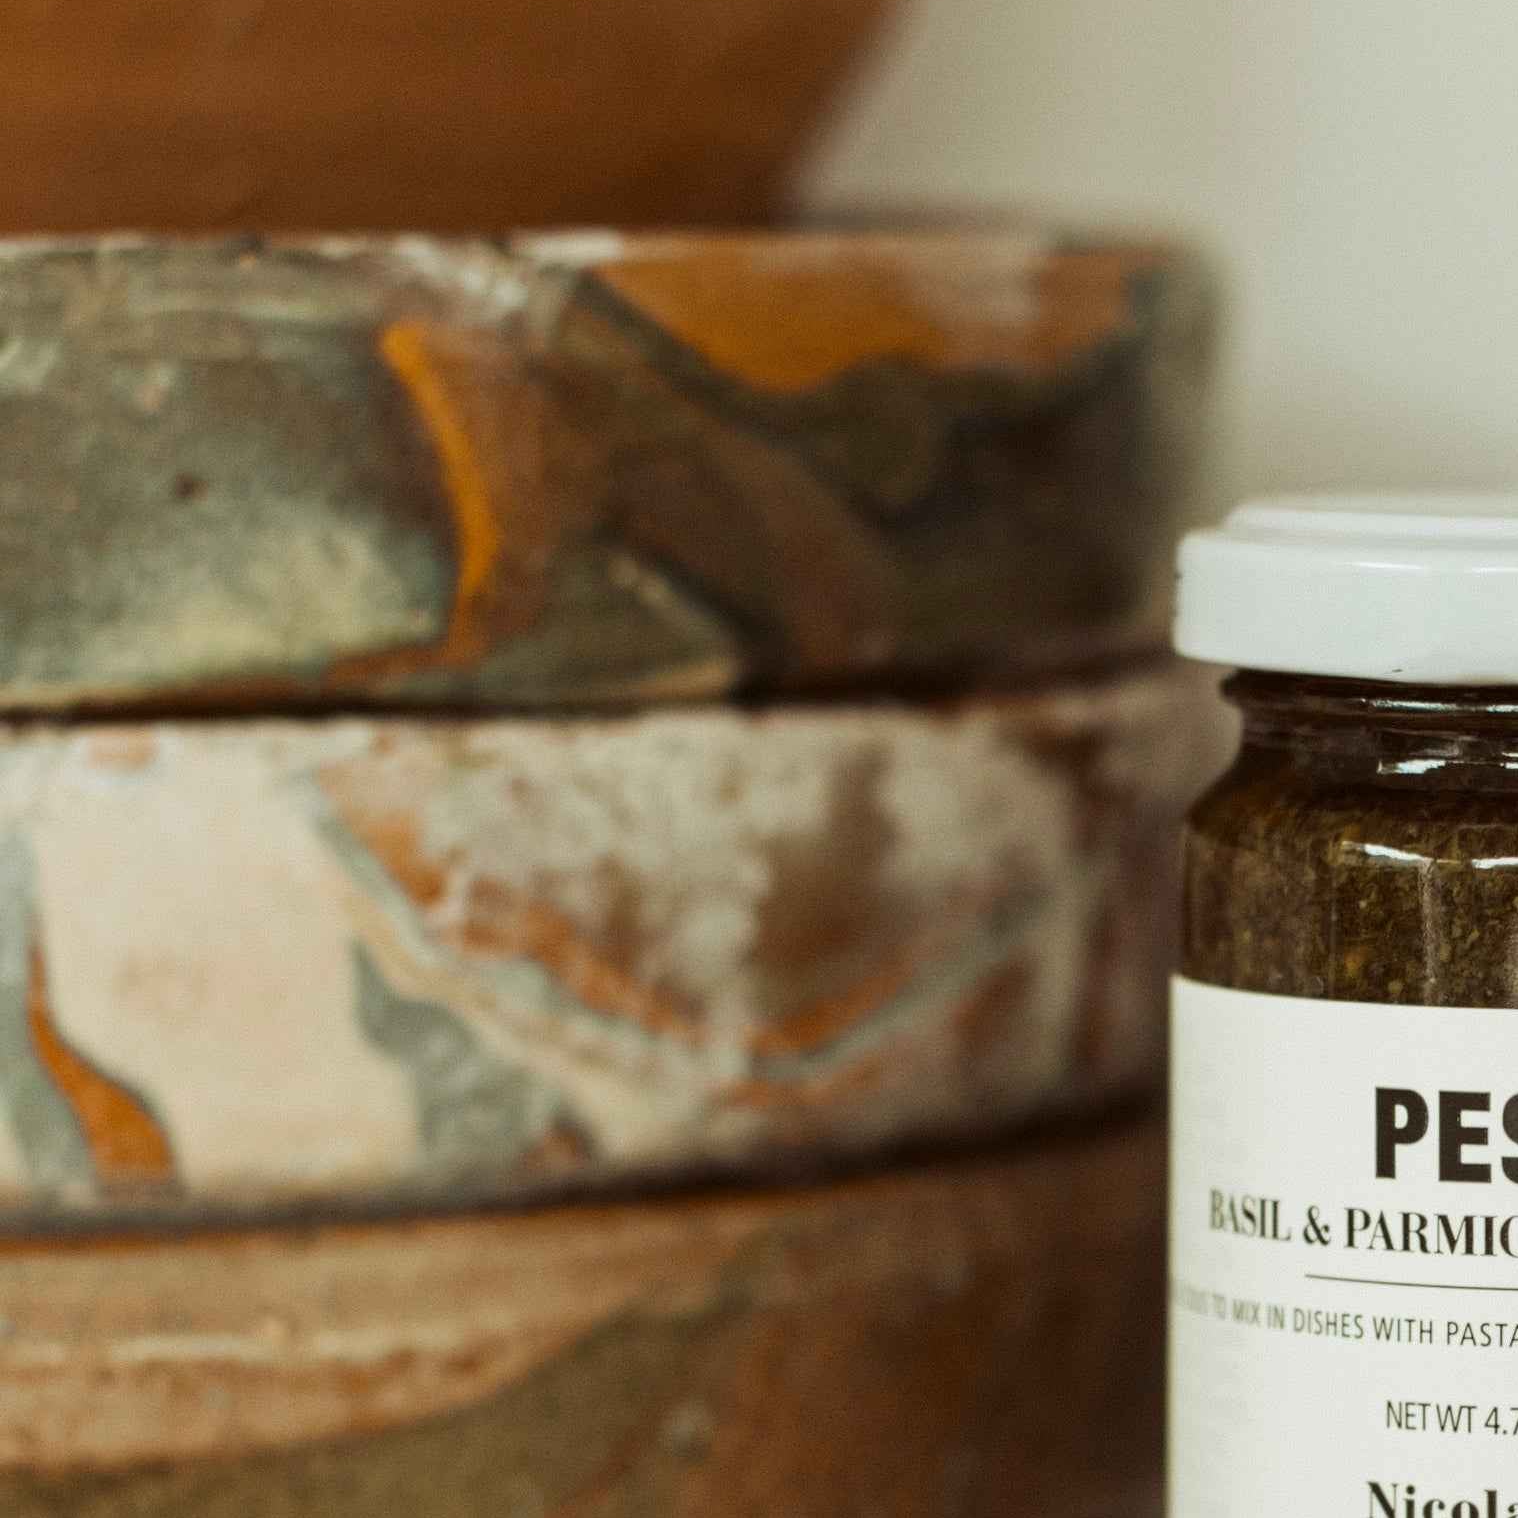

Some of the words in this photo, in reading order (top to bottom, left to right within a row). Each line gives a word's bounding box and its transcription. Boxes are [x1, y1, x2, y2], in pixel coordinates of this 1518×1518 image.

[1209, 1189, 1292, 1242] BASIL
[1303, 1205, 1331, 1247] &
[1231, 1299, 1261, 1326] MIX
[1267, 1305, 1285, 1330] IN
[1293, 1307, 1364, 1340] DISHES
[1373, 1317, 1433, 1344] WITH
[1386, 1400, 1431, 1431] NET
[1436, 1404, 1477, 1434] WT
